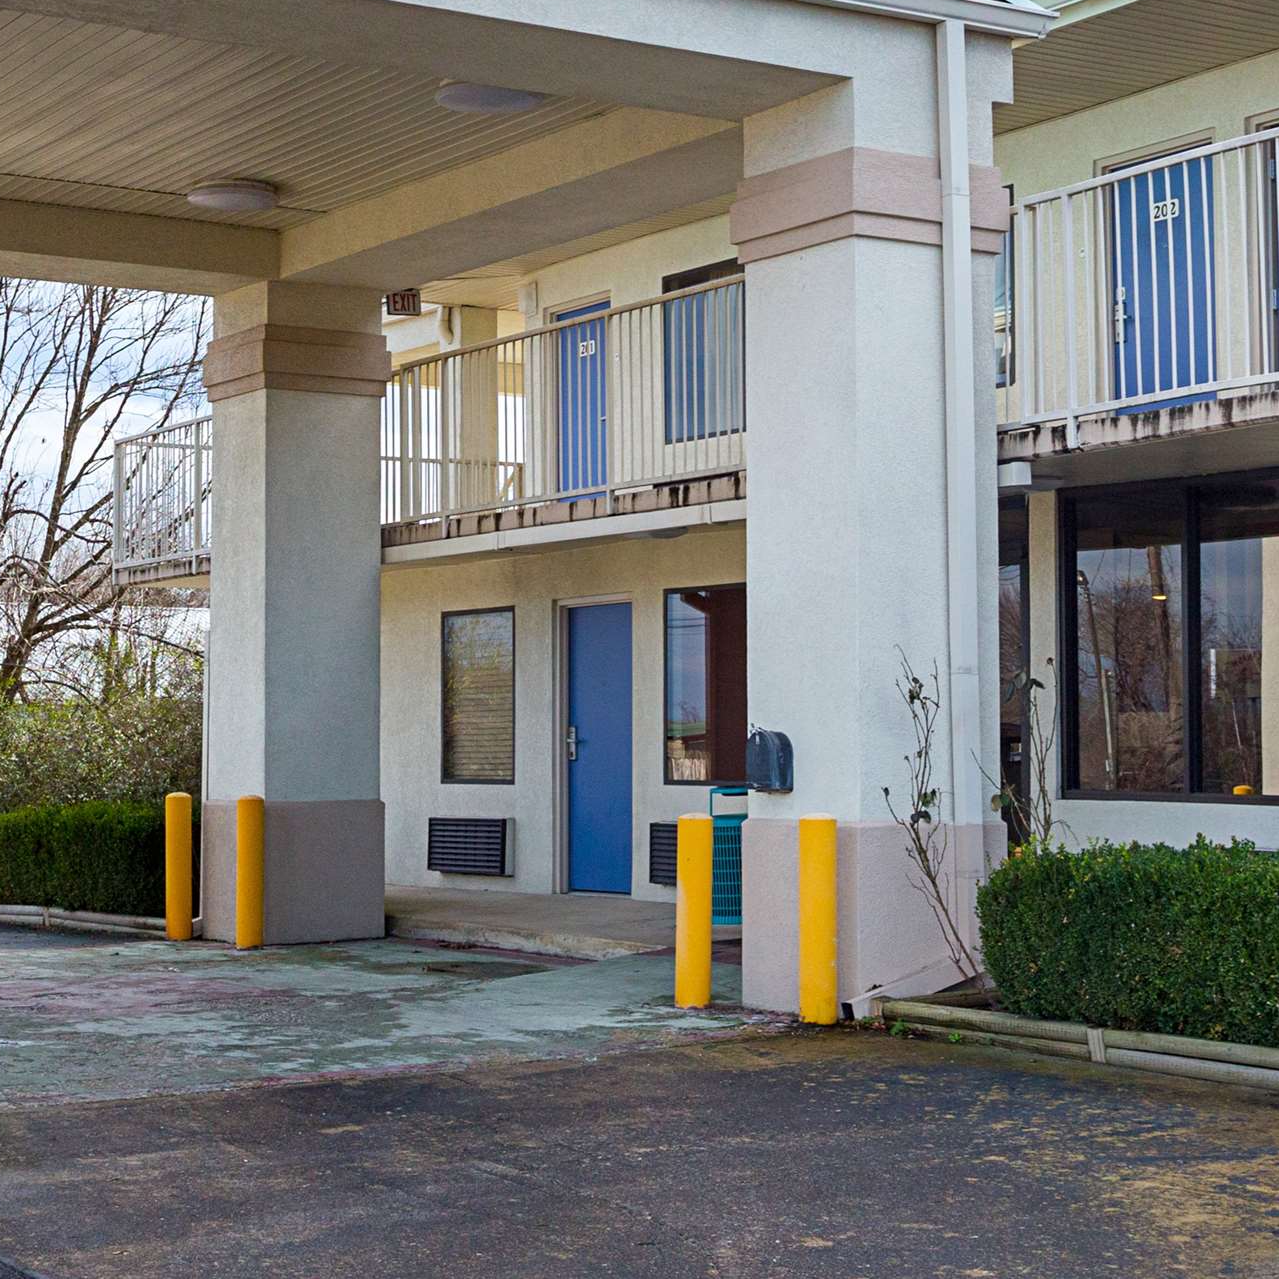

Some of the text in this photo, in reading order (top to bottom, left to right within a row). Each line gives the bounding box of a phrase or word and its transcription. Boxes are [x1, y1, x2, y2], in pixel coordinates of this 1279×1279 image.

[1153, 201, 1177, 220] 202
[392, 292, 418, 313] EXIT
[580, 342, 594, 355] 21
